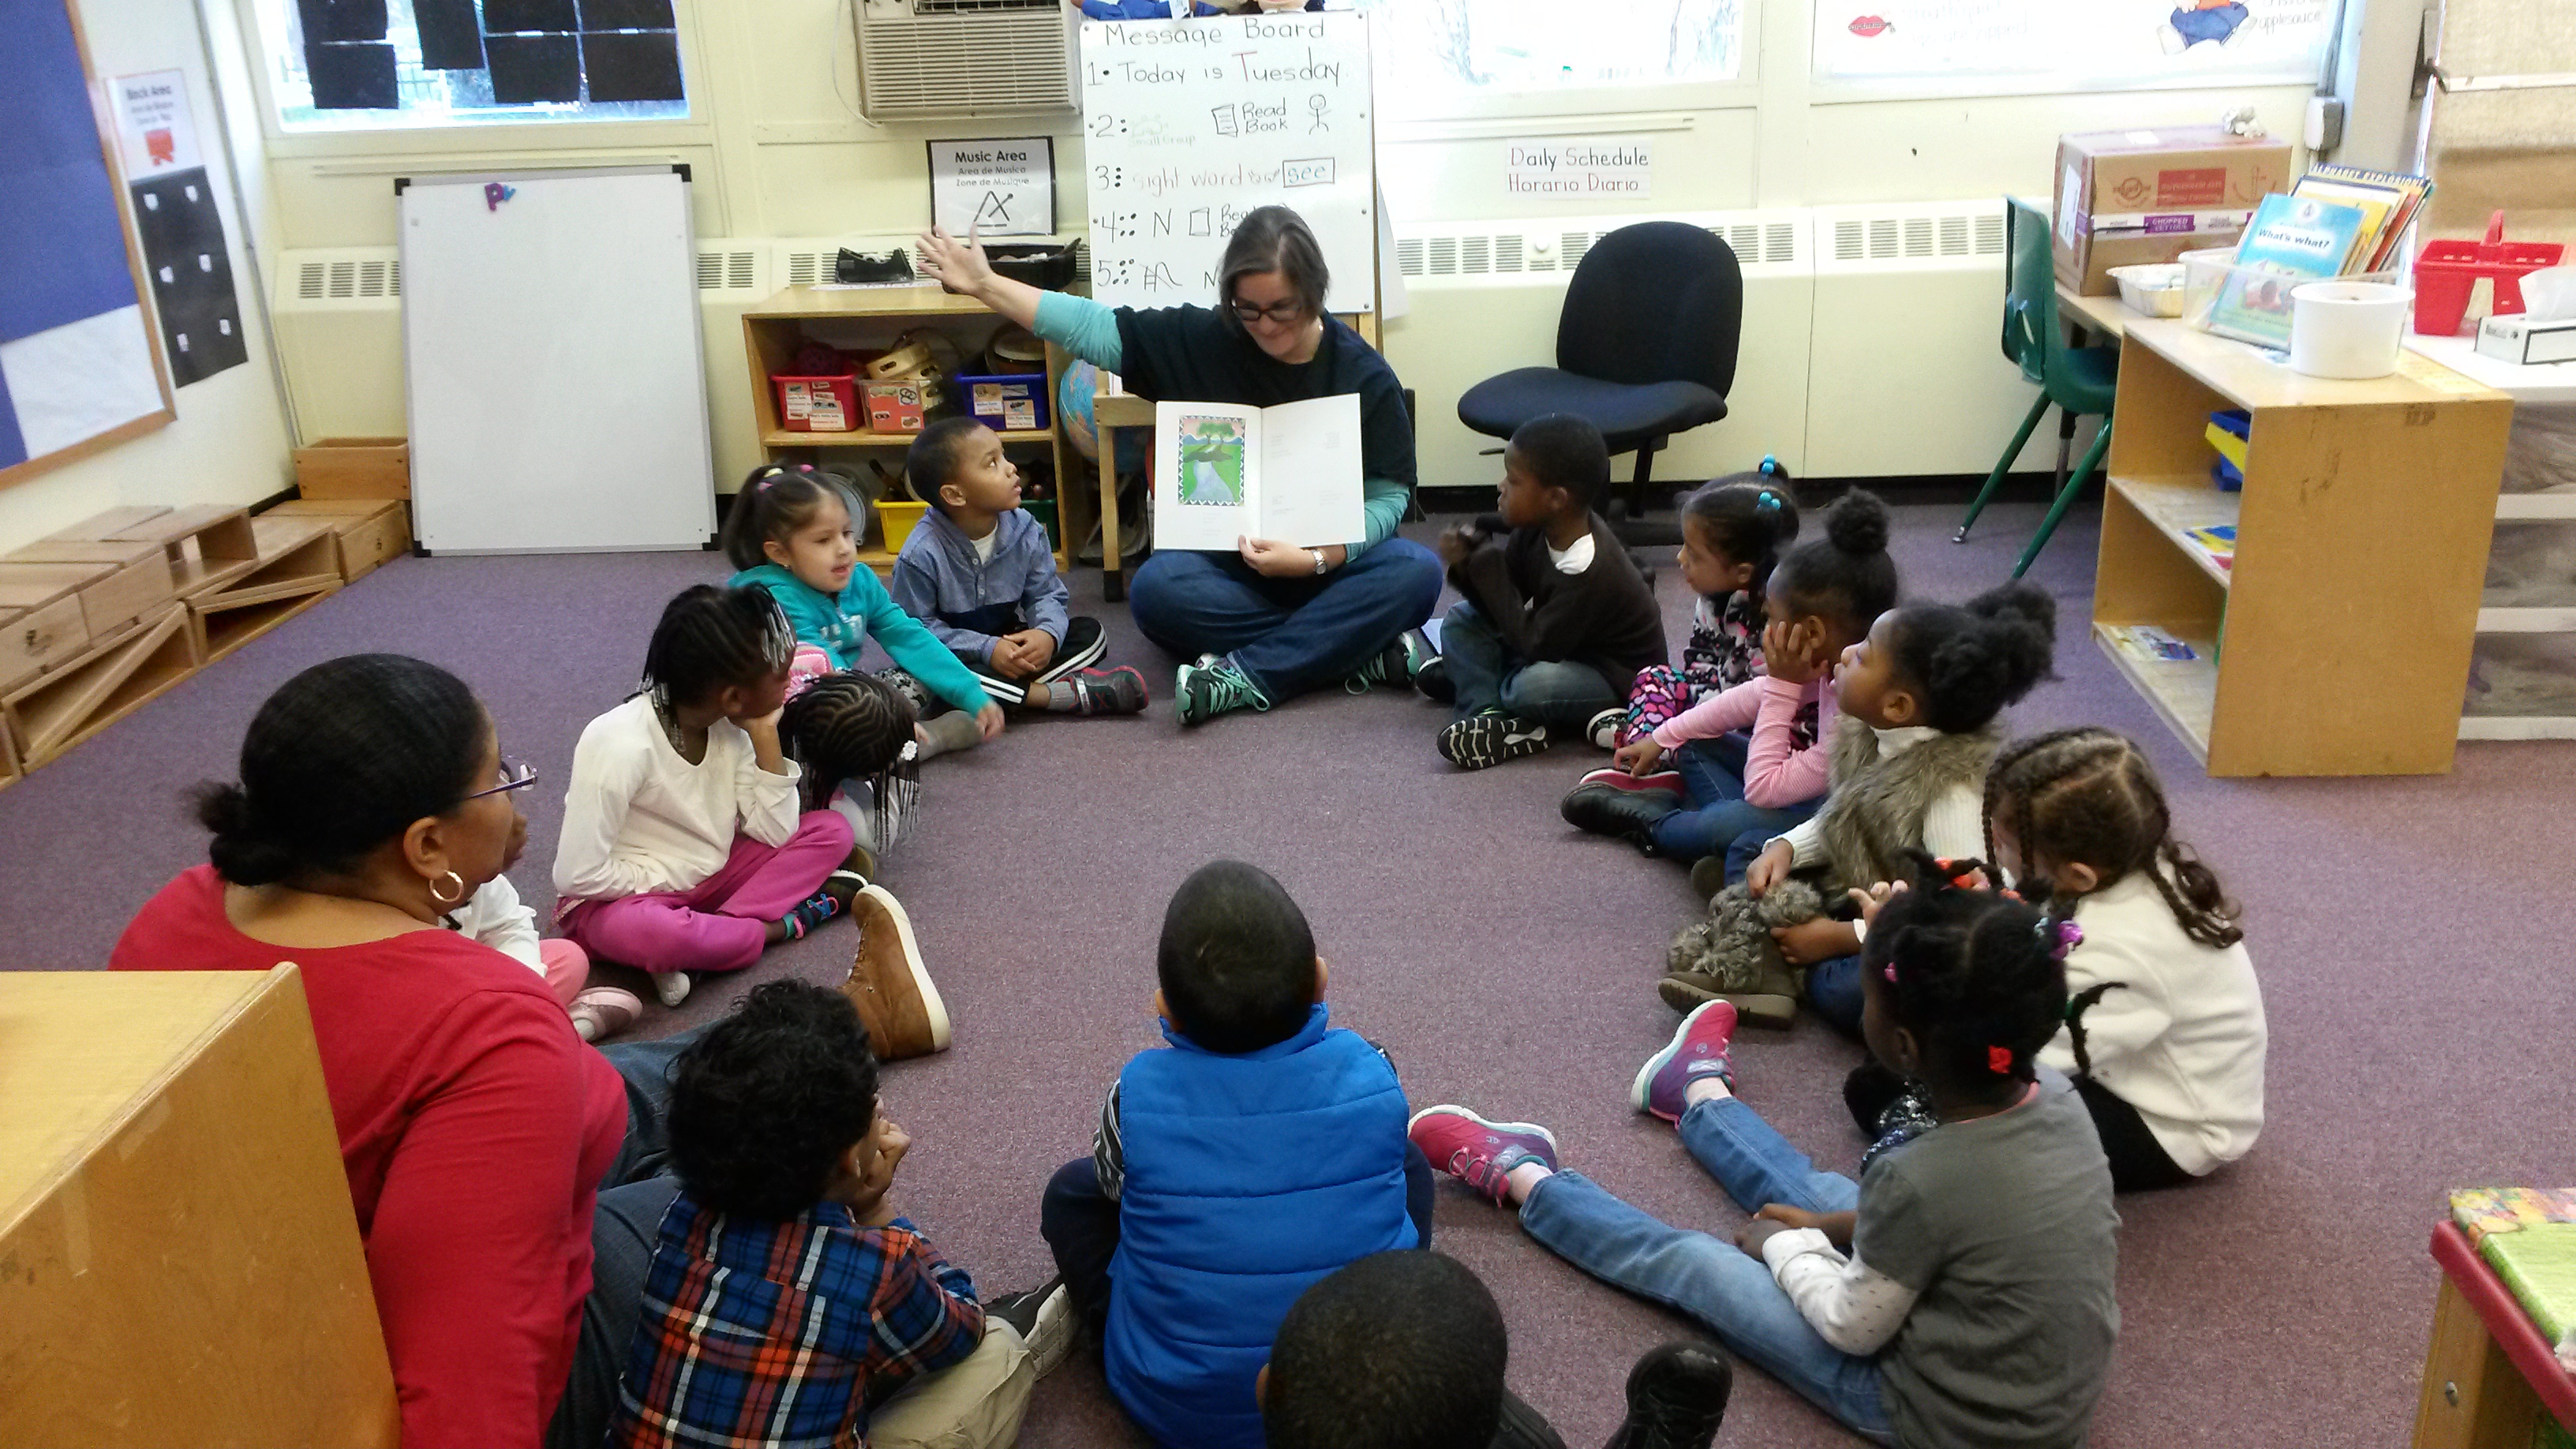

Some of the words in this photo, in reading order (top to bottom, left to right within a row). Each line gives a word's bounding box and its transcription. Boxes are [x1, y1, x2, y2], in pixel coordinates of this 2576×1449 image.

[1106, 23, 1222, 48] Message
[1244, 17, 1324, 39] Board
[2259, 10, 2321, 36] applesauce
[1118, 62, 1185, 84] Today
[1204, 68, 1223, 79] is
[1232, 46, 1339, 87] Tuesday
[1242, 97, 1286, 120] Read
[1245, 118, 1288, 134] Book
[955, 150, 992, 163] Music
[996, 149, 1028, 162] Area
[1511, 148, 1557, 172] Daily
[1566, 146, 1649, 167] Schedule
[958, 167, 979, 176] Area
[982, 167, 993, 175] de
[1133, 167, 1179, 197] sight
[1191, 163, 1242, 186] word
[1287, 166, 1326, 184] see
[1508, 173, 1579, 192] Horario
[1588, 172, 1639, 192] Diario
[2152, 217, 2188, 226] CHOPPED
[2259, 229, 2291, 242] What's
[2295, 237, 2330, 249] what?
